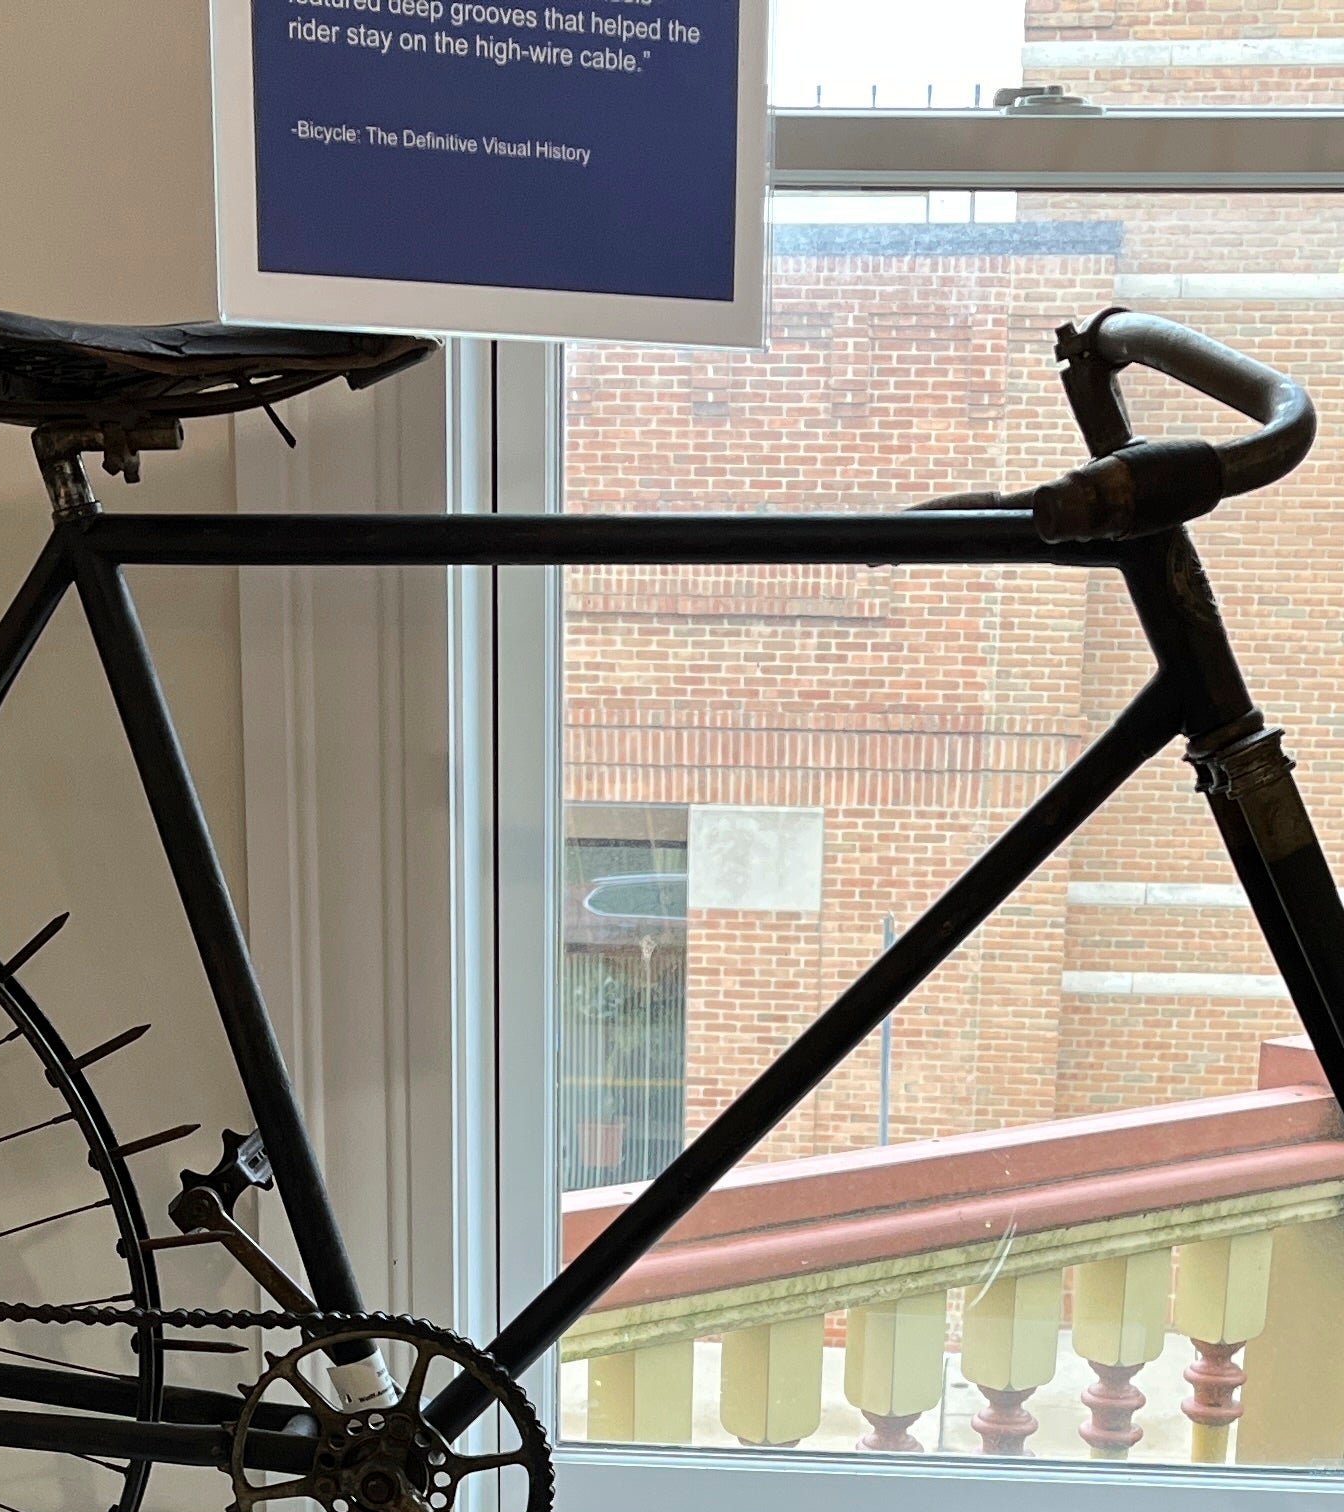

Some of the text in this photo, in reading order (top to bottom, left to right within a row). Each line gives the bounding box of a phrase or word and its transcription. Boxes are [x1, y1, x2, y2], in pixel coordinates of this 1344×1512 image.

[288, 15, 651, 73] rider stay on the high-wire cable."
[388, 0, 444, 24] deep
[450, 2, 538, 28] grooves
[543, 6, 585, 34] that
[591, 11, 661, 43] helped
[667, 19, 701, 44] the
[290, 119, 591, 167] -Bicycle: The Definitive Visual History
